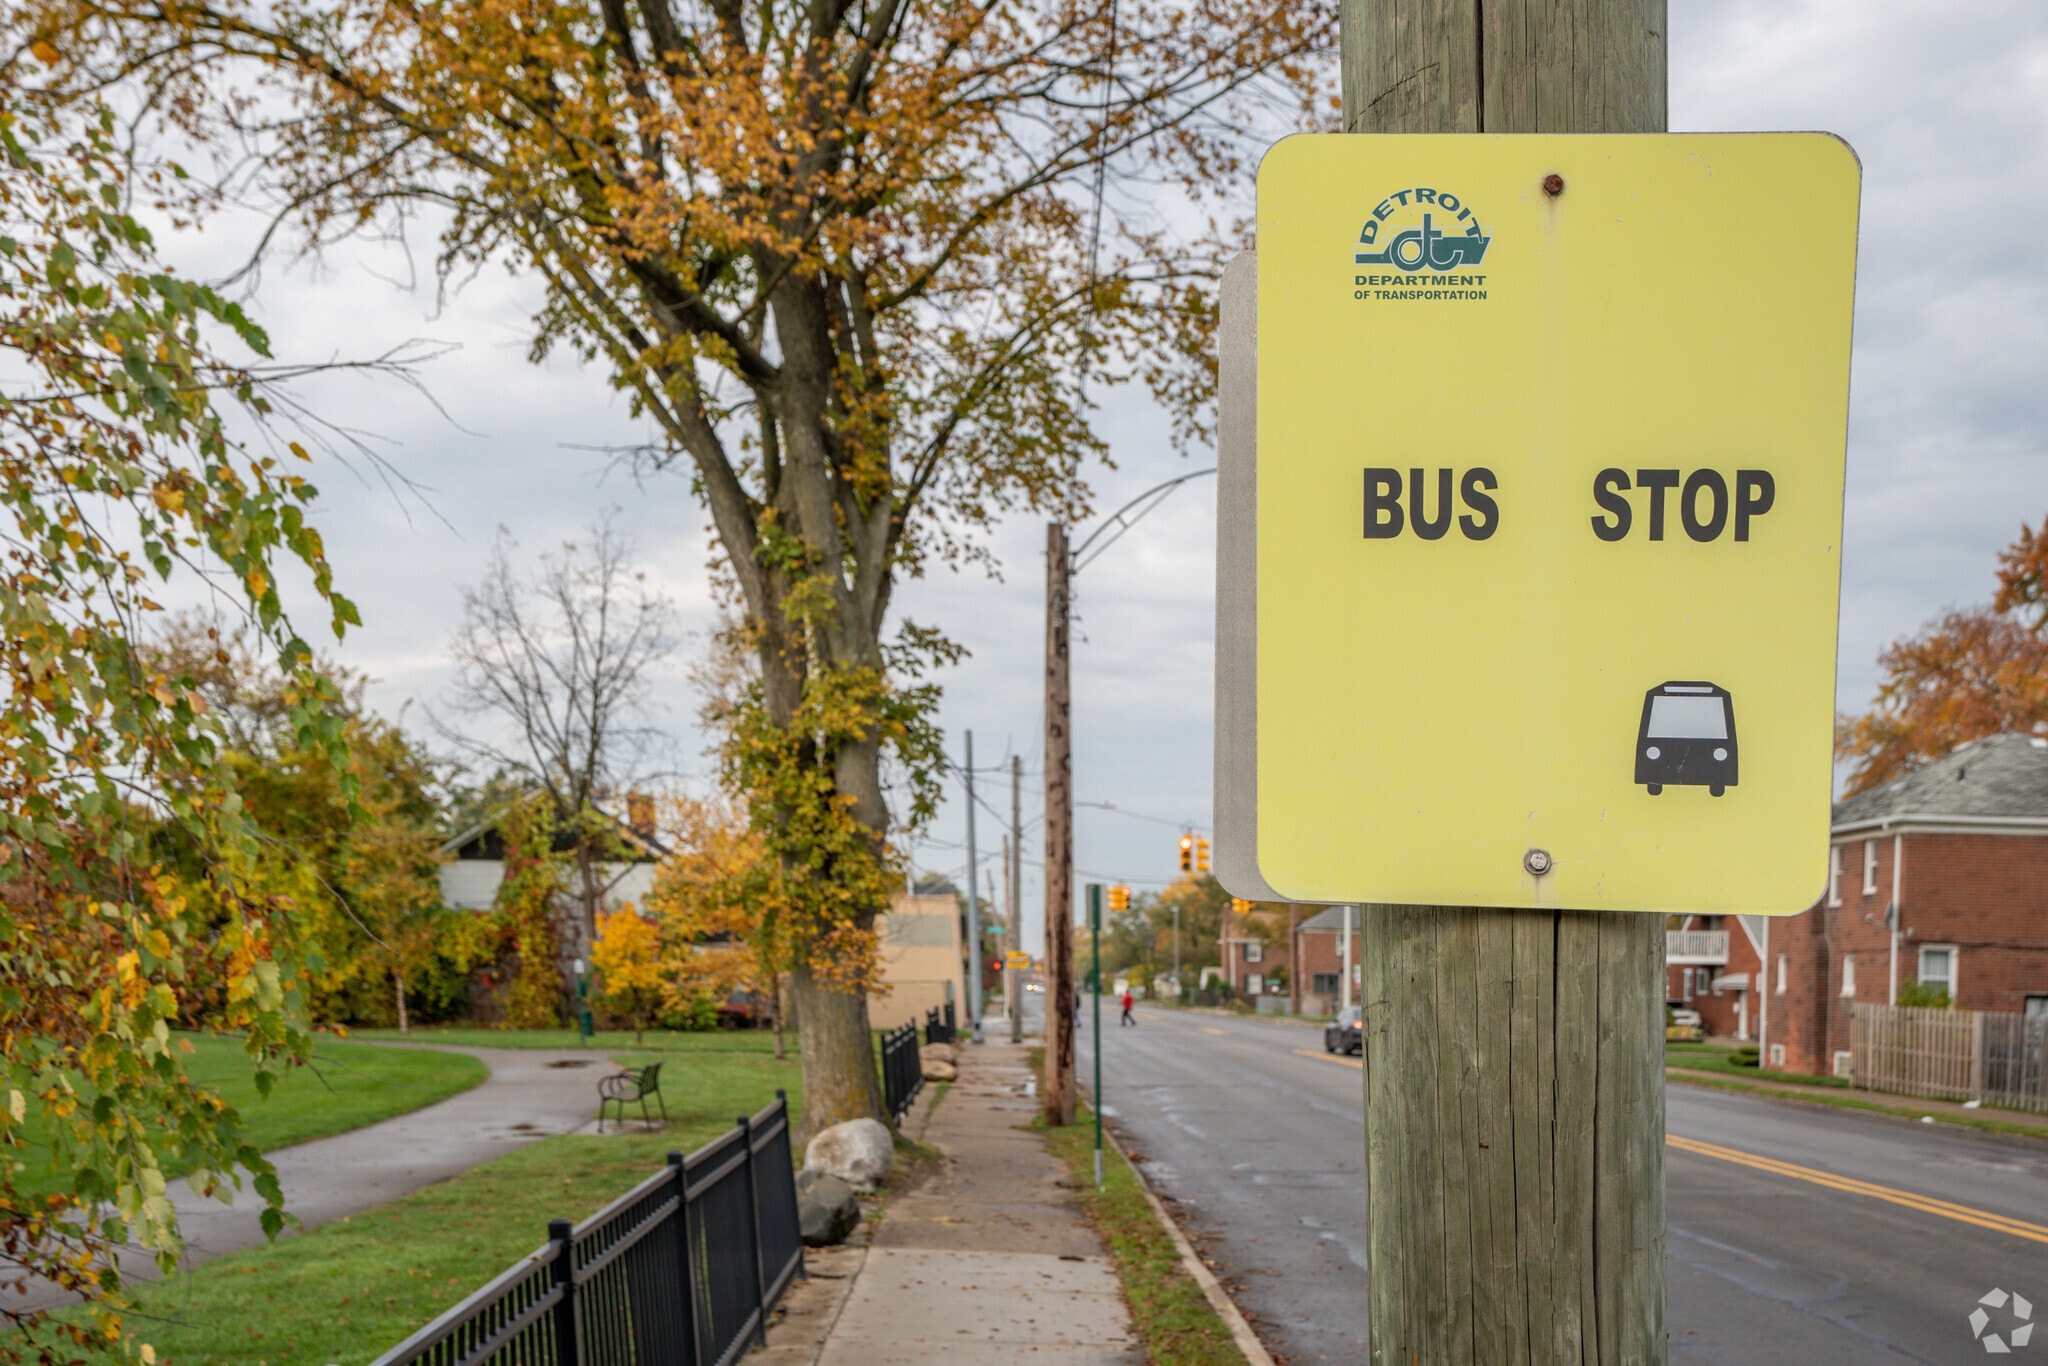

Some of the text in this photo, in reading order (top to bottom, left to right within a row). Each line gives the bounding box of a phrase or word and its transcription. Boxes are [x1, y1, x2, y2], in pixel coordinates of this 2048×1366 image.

[1359, 187, 1484, 245] DETROIT
[1354, 275, 1488, 286] DEPARTMENT
[1354, 290, 1488, 300] OF TRANSPORTATION
[1362, 466, 1777, 543] BUS STOP
